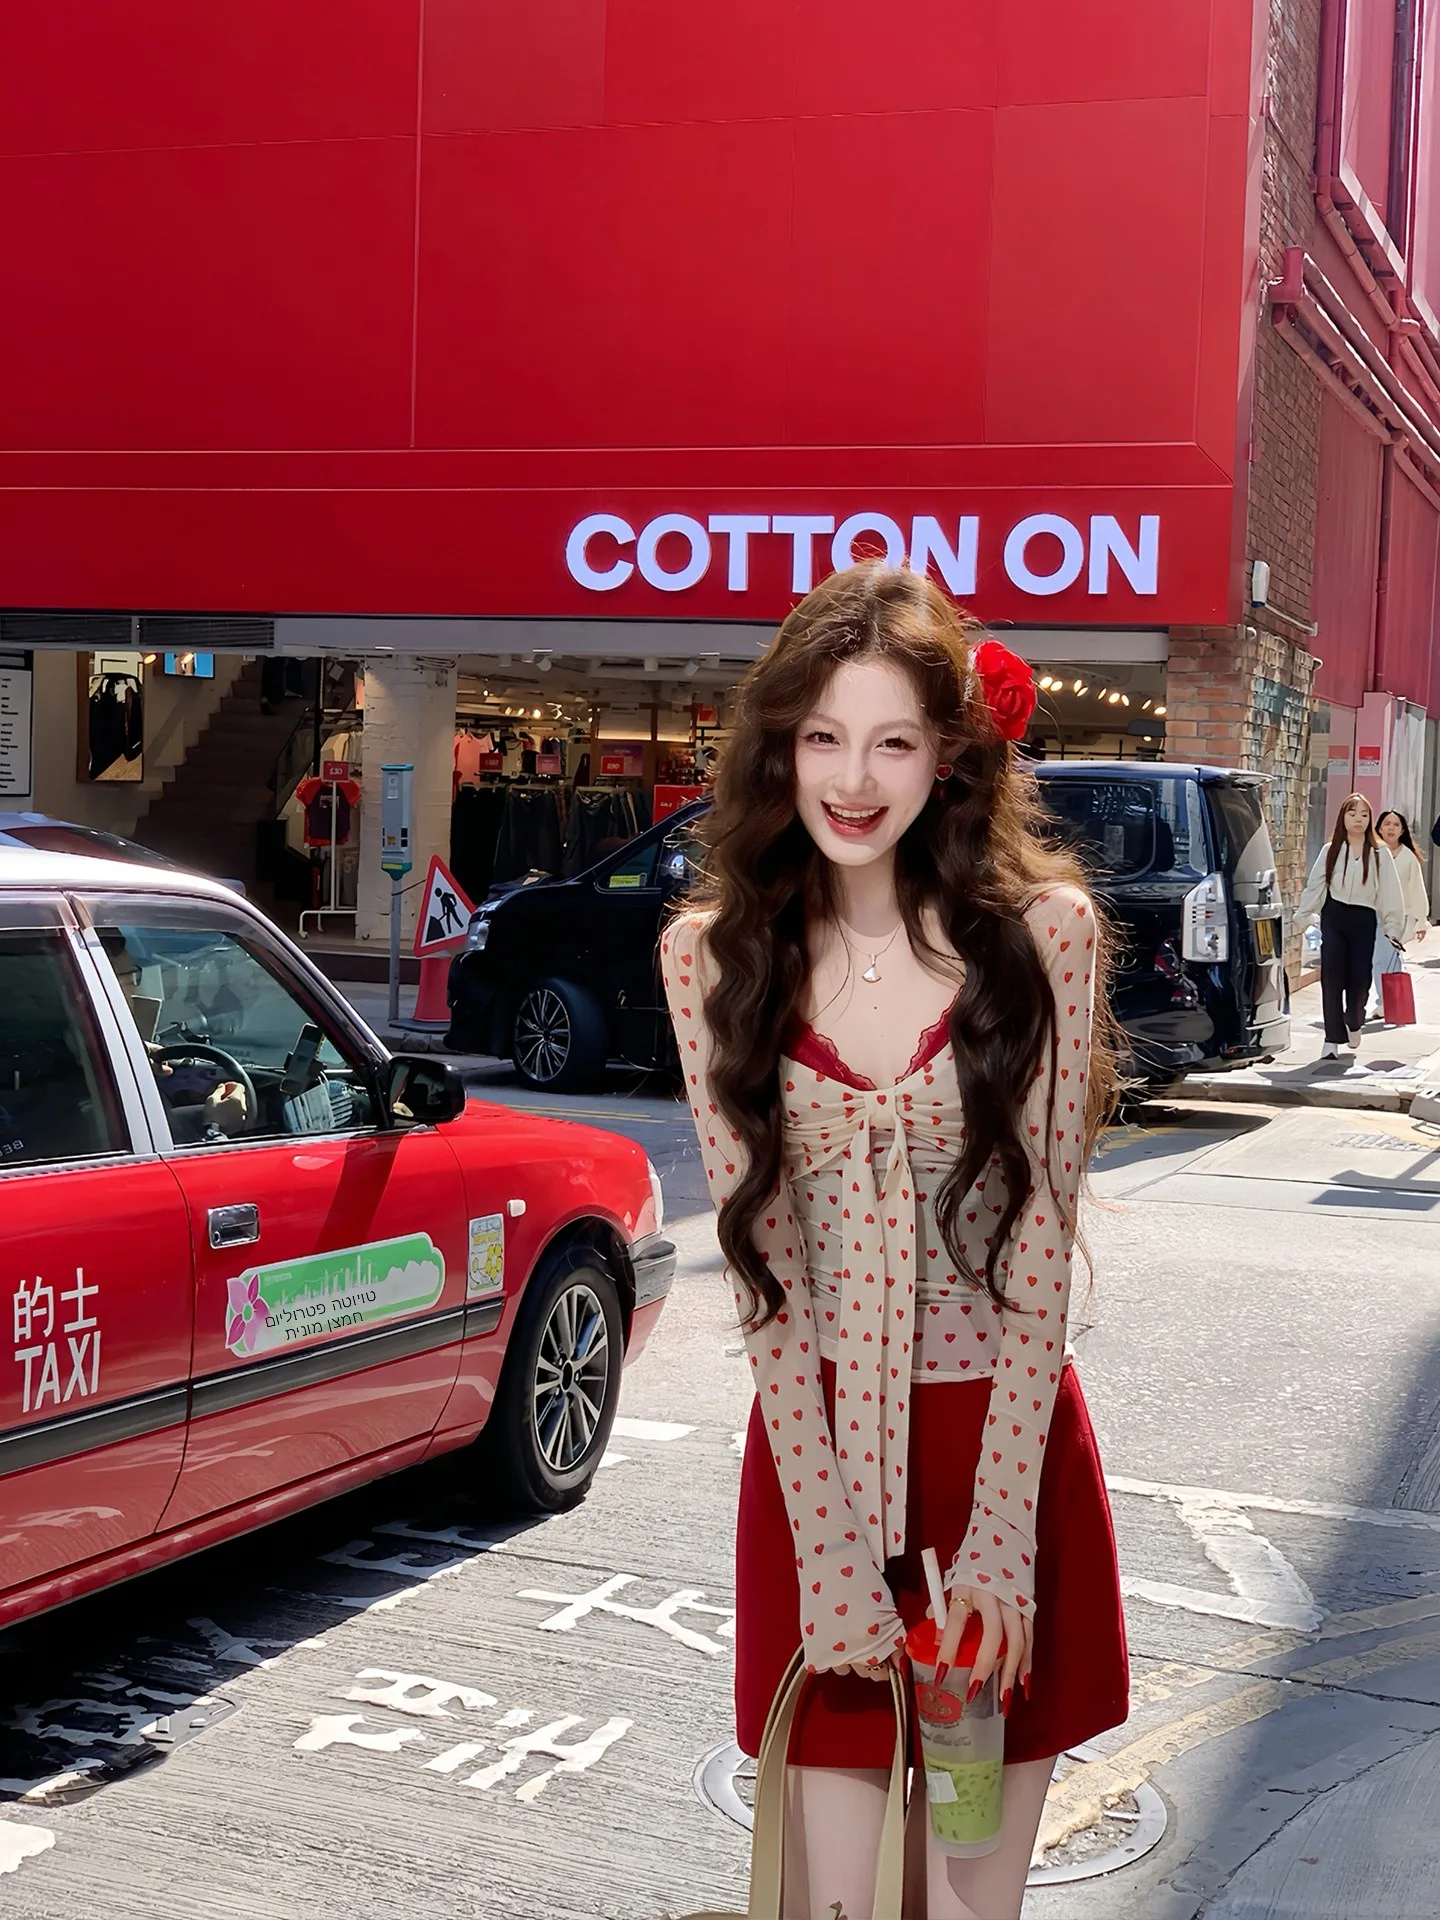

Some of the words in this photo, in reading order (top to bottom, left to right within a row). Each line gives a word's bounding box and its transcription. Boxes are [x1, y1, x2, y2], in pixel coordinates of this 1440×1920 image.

[565, 511, 979, 596] COTTON
[1003, 512, 1160, 597] ON
[13, 1267, 99, 1343] 的士
[332, 1290, 376, 1311] טויוטה
[264, 1303, 327, 1328] פטרוליום
[327, 1311, 364, 1332] חמצן
[285, 1321, 323, 1340] מונית
[14, 1330, 101, 1413] TAXI
